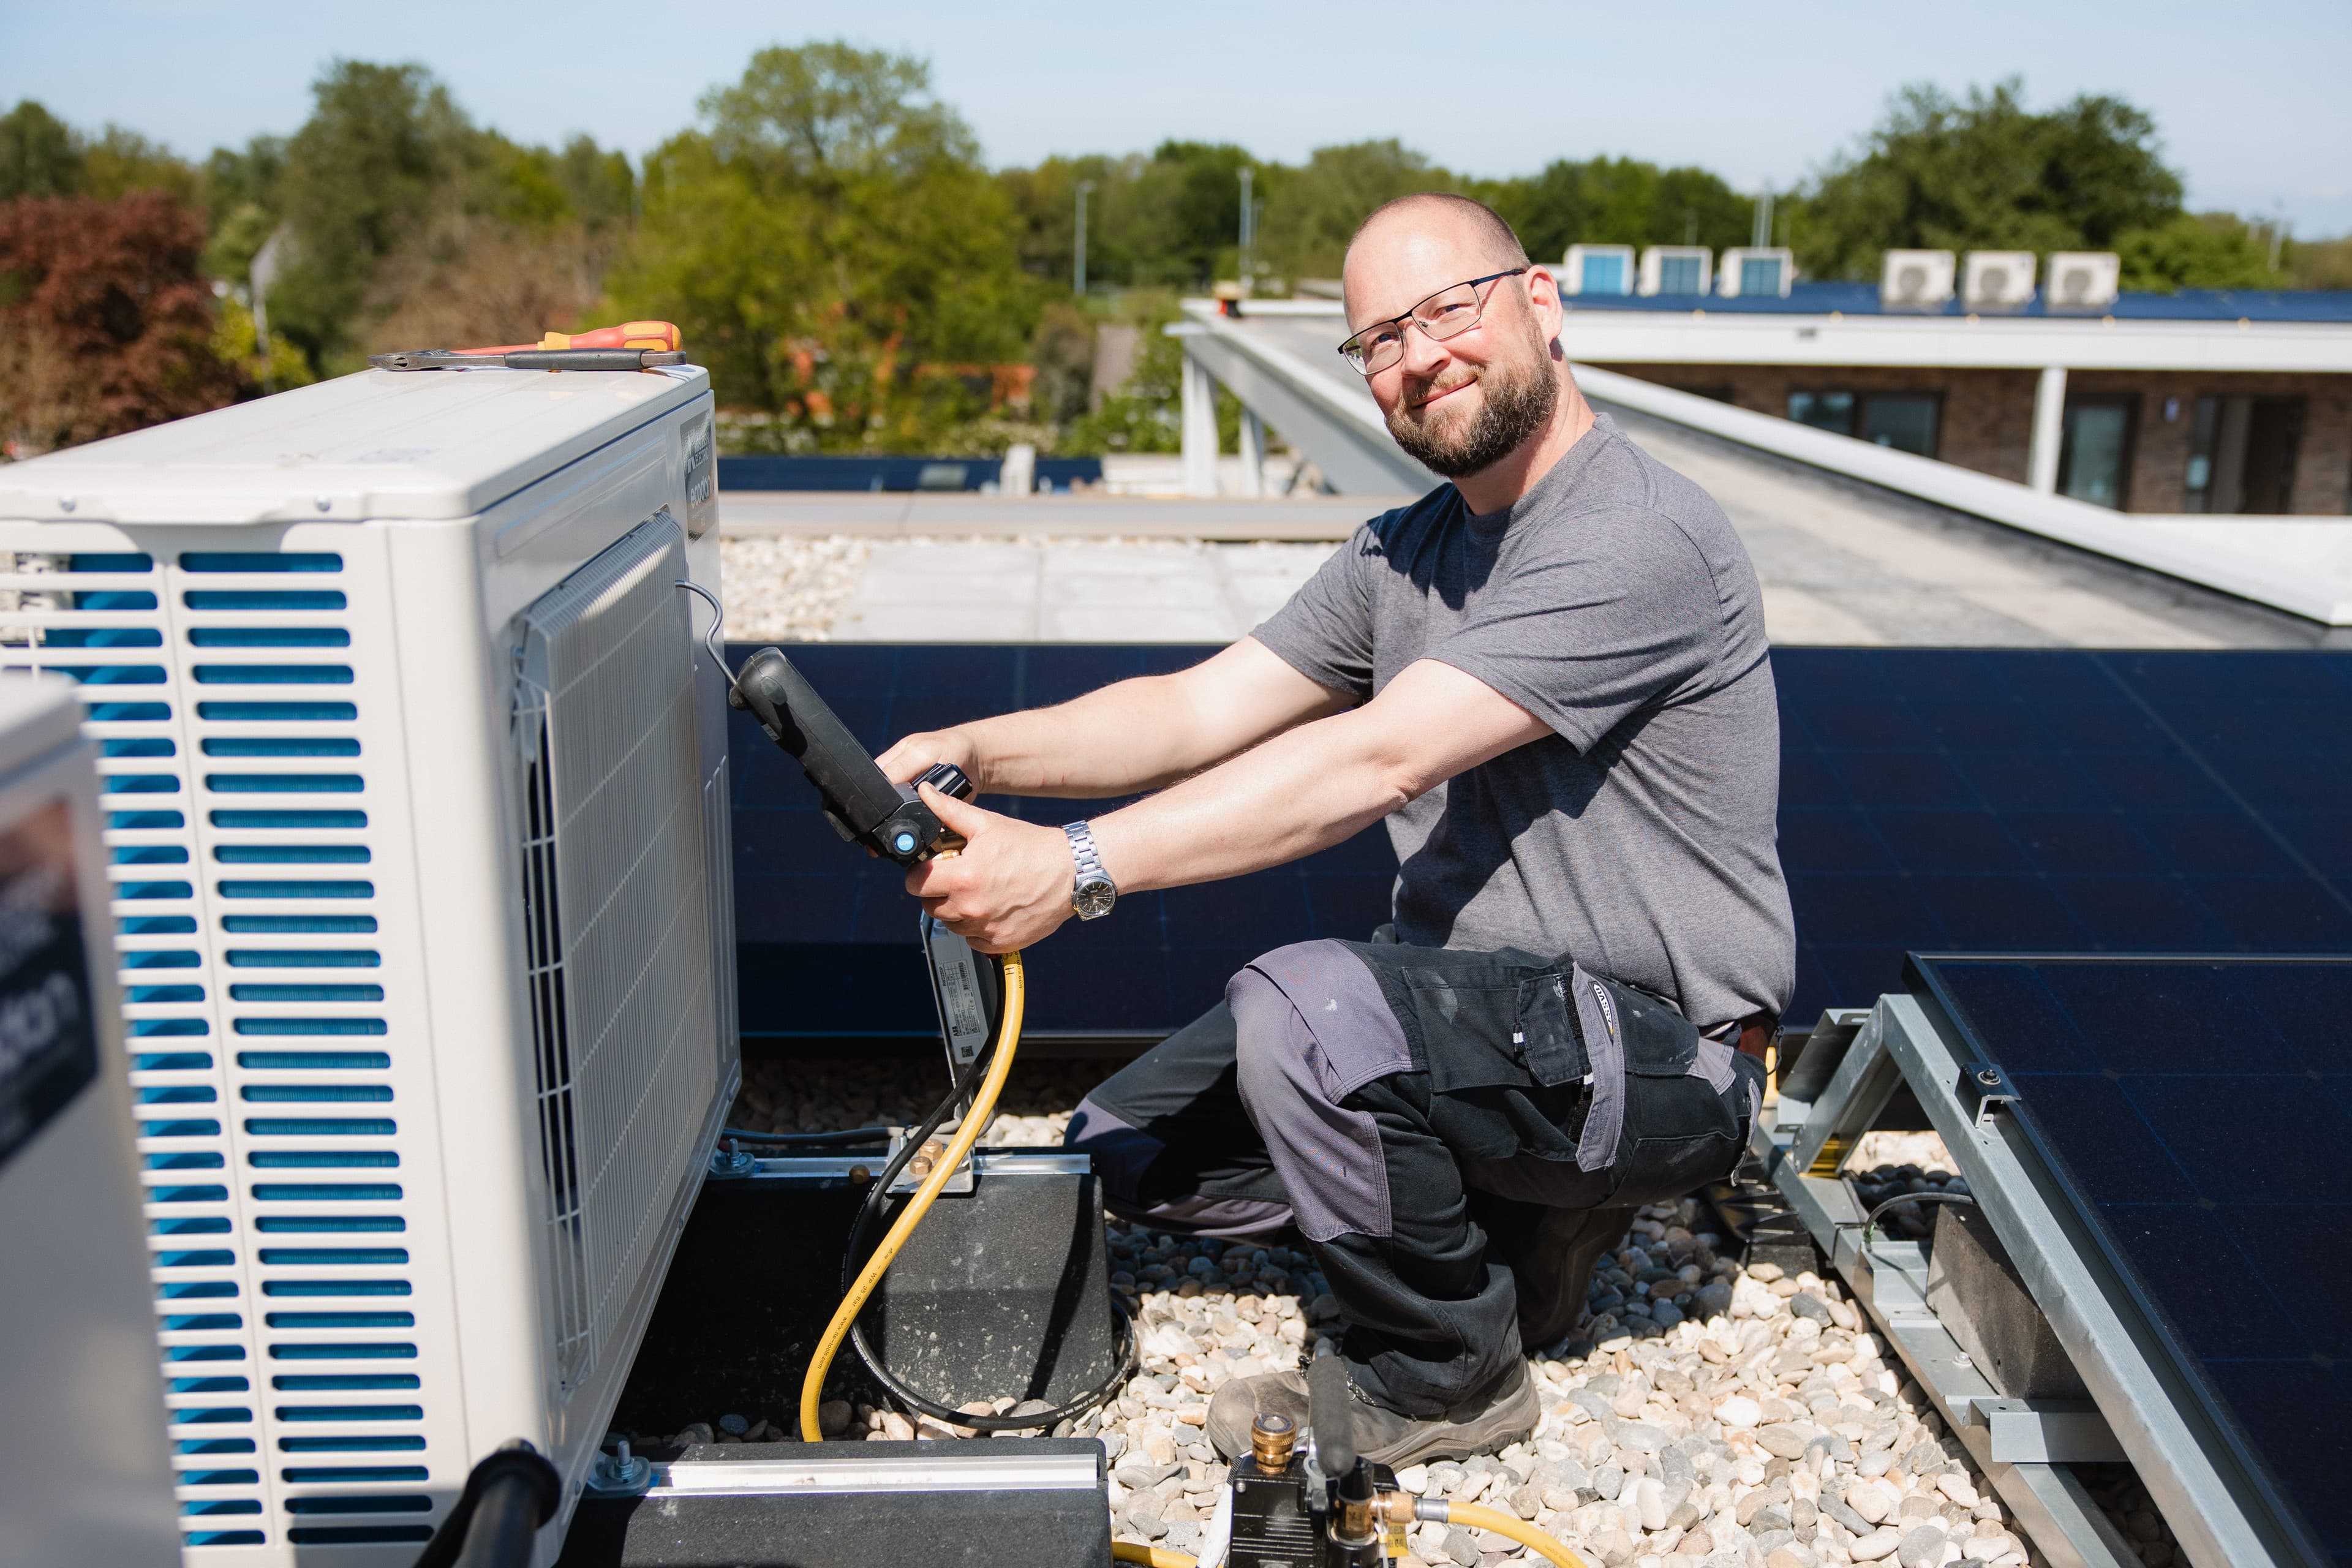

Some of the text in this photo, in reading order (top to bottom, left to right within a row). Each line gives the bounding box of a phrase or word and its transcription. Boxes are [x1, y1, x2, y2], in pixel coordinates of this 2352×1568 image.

[690, 475, 711, 509] ecodan
[1596, 987, 1611, 1023] DASSY
[869, 1272, 877, 1283] WP
[861, 1285, 868, 1294] 35
[852, 1295, 861, 1307] Bar
[854, 1340, 867, 1361] BARRIER
[865, 1360, 892, 1387] REFRIGERANT
[889, 1384, 899, 1393] ALL
[897, 1390, 919, 1407] PREMIUM
